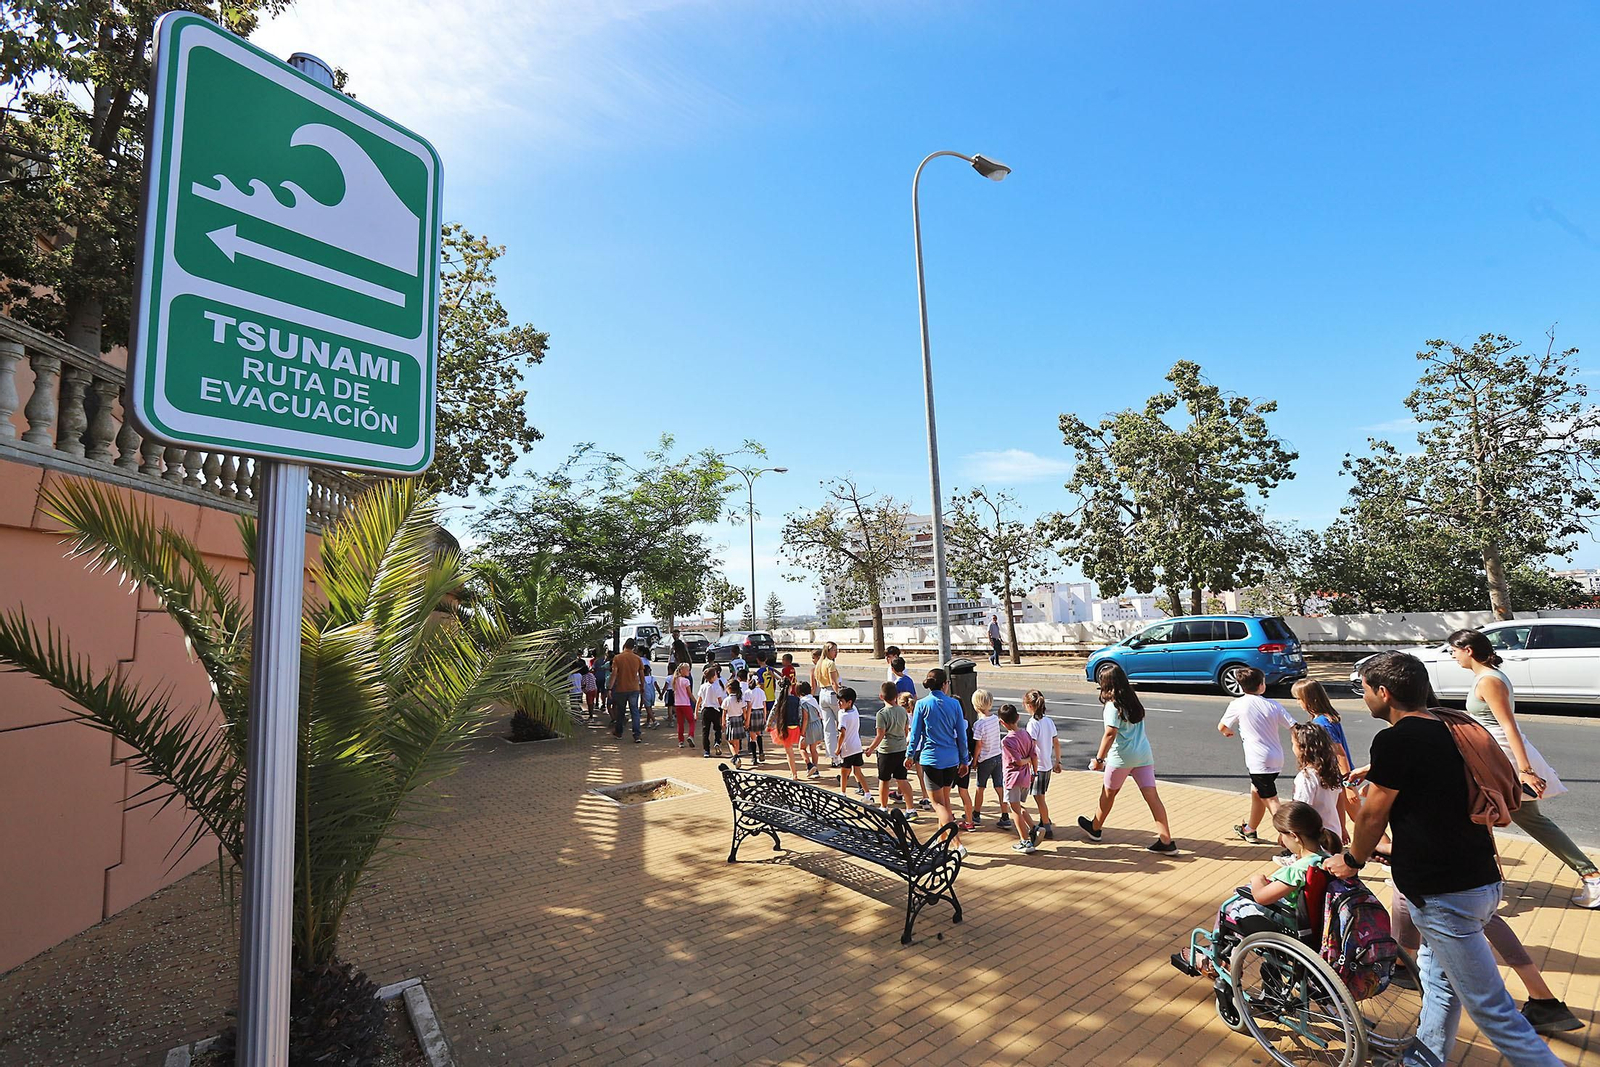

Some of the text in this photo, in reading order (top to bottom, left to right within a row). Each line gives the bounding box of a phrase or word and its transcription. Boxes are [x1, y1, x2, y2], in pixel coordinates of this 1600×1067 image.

[204, 311, 399, 385] TSUNAMI
[201, 377, 398, 435] EVACUACIÓN
[243, 357, 370, 404] RUTA DE
[766, 676, 773, 689] 7
